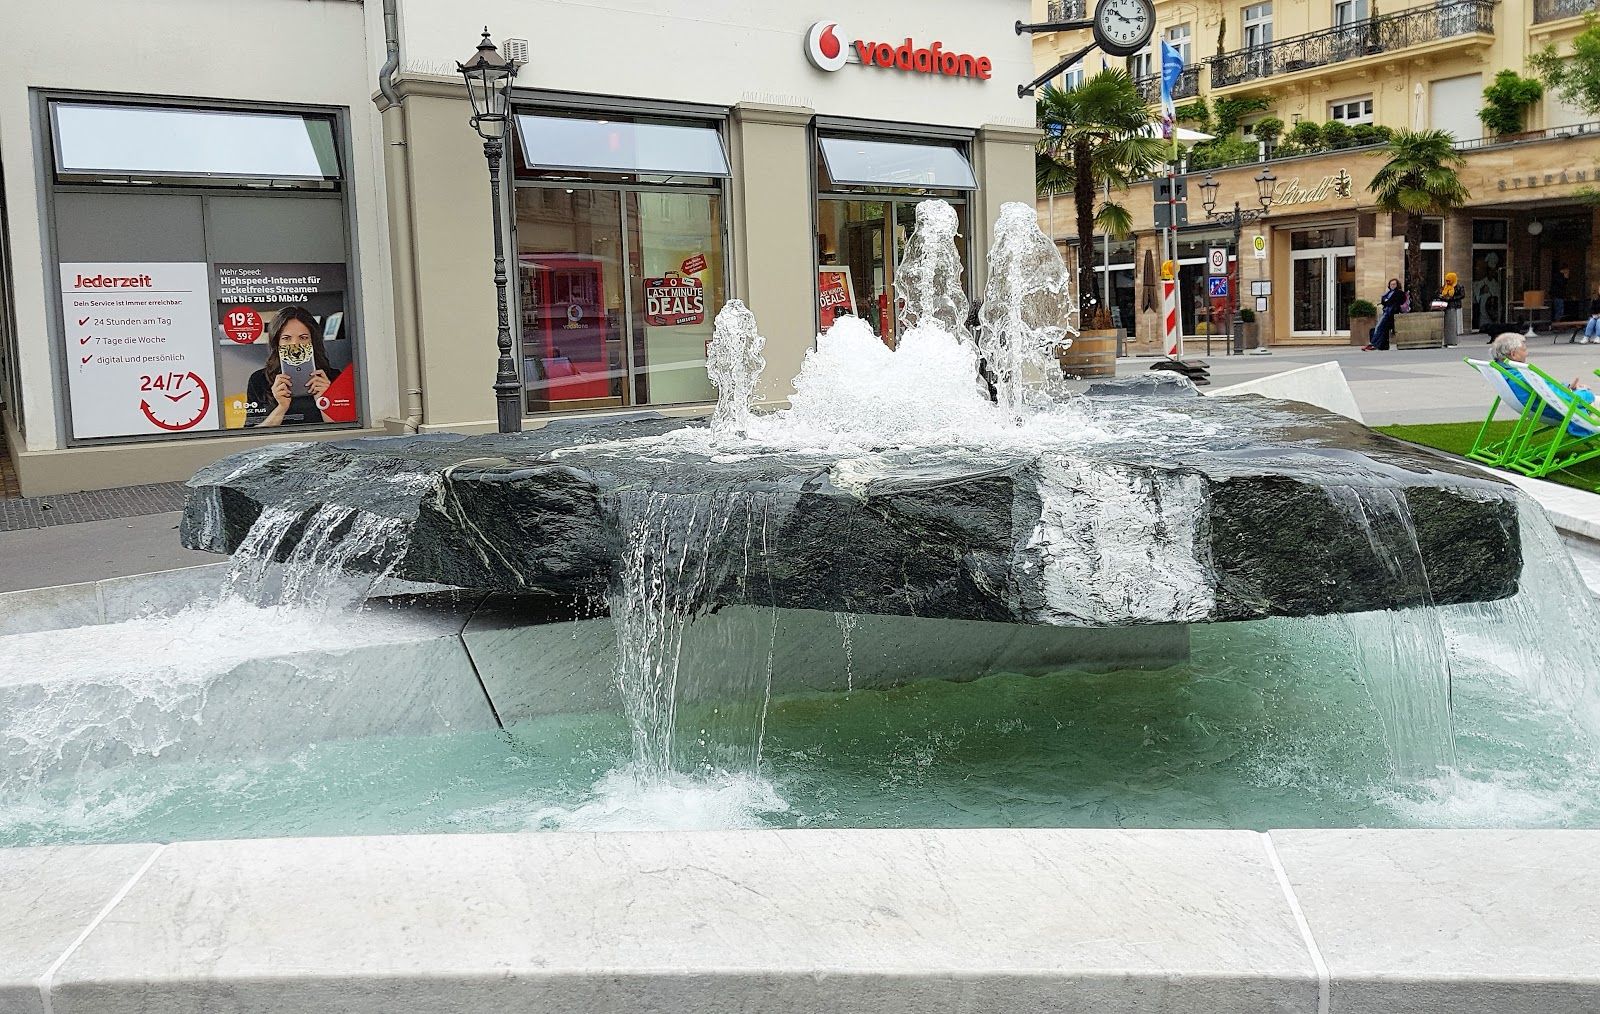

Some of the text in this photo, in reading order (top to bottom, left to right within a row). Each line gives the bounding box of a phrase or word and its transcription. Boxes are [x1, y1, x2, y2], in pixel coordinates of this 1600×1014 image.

[854, 37, 992, 80] vodafone
[1270, 176, 1335, 206] Lindt
[1214, 254, 1222, 263] 30
[219, 268, 261, 277] Mehr Speed:
[74, 273, 152, 289] Jederzeit
[220, 276, 321, 286] Highspeed-Internet für
[221, 285, 318, 294] ruckelfreies Streamen
[646, 287, 703, 298] LAST MINUTE
[221, 295, 238, 304] mit
[239, 295, 252, 303] bis
[265, 294, 278, 303] 50
[278, 293, 308, 303] Mbit/s
[819, 292, 846, 307] DEALS
[647, 296, 704, 315] DEALS
[94, 318, 104, 326] 24
[106, 317, 140, 326] Stunden
[157, 317, 172, 327] Tag
[228, 312, 246, 326] 19
[95, 335, 166, 347] 7 Tage die Woche
[97, 353, 185, 366] digital und persönlich
[139, 371, 185, 391] 24/7
